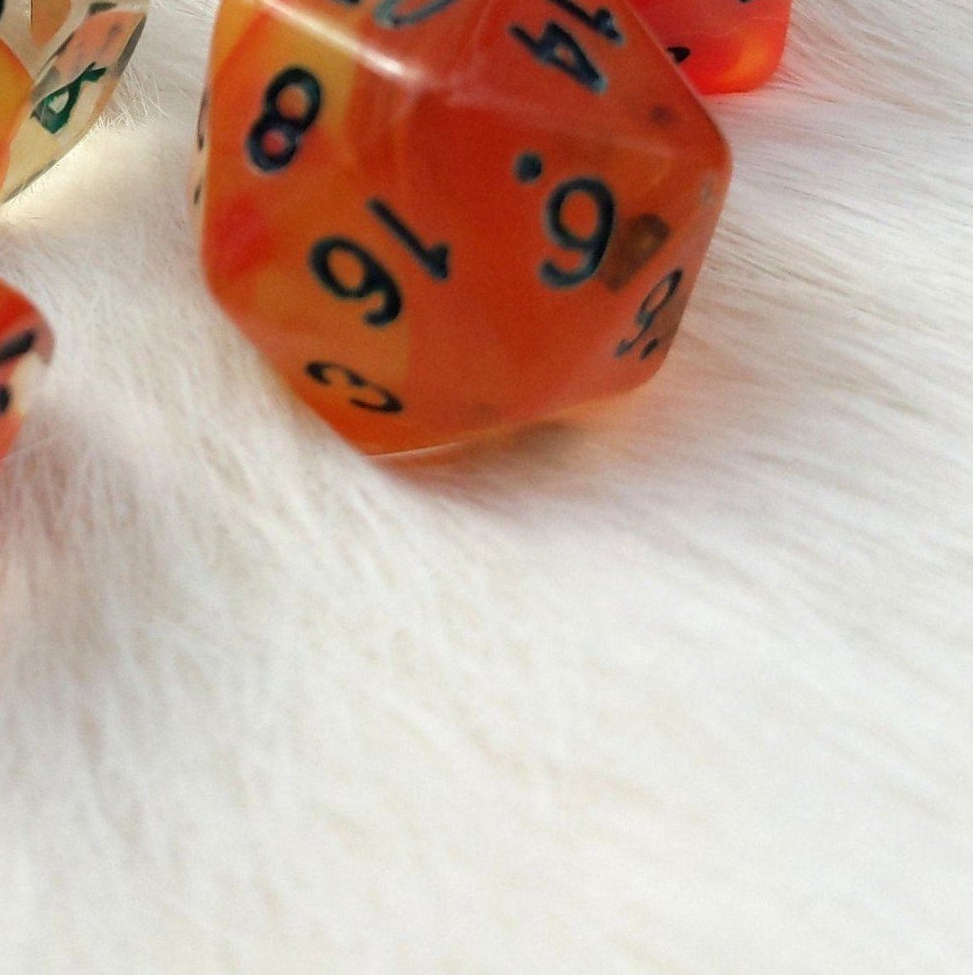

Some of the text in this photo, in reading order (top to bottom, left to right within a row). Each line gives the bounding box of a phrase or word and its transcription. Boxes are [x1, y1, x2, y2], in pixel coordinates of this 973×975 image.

[244, 65, 323, 174] 8
[307, 197, 453, 327] 16
[305, 360, 403, 416] 3
